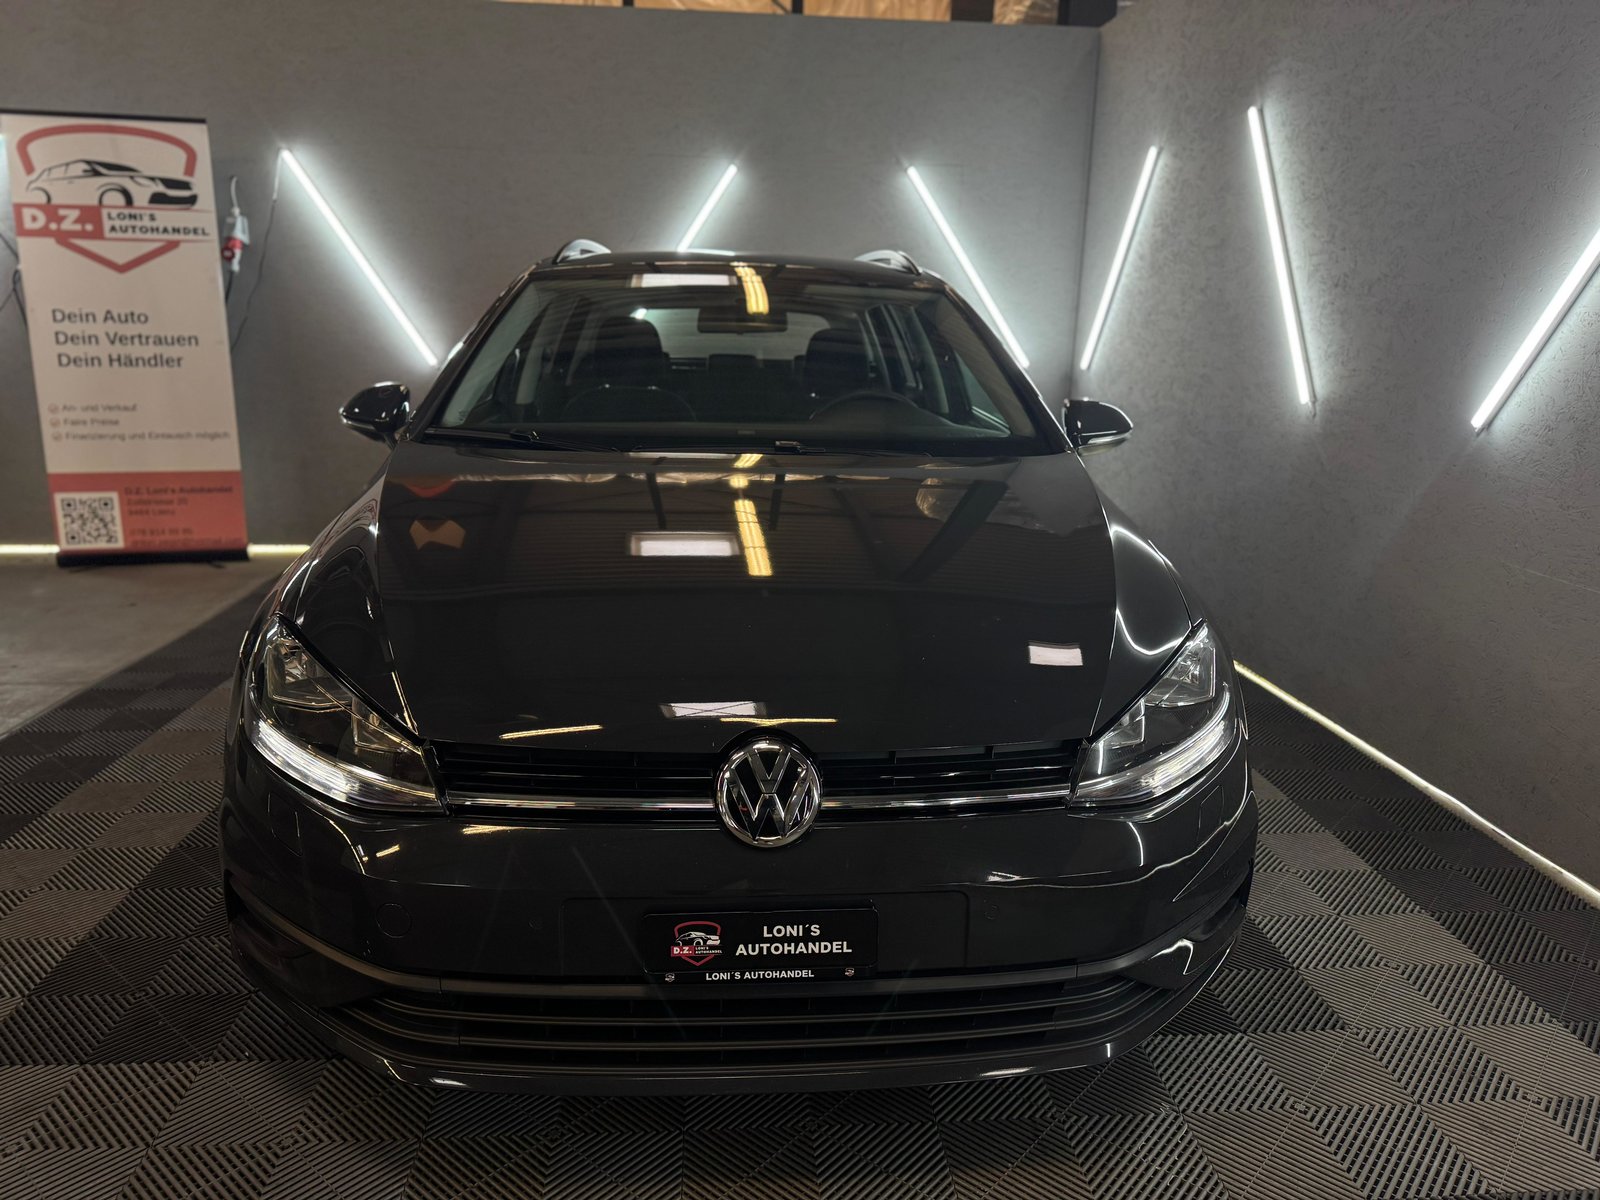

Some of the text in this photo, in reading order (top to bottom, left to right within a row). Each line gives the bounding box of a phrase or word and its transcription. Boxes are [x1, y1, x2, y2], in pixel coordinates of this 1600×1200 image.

[21, 206, 94, 231] D.Z.
[107, 211, 156, 222] LONI'S
[108, 224, 210, 237] AUTOHANDEL
[51, 308, 149, 324] Dein Auto
[54, 331, 199, 347] Dein Vertrauen
[57, 353, 183, 368] Dein Händler
[81, 403, 98, 412] und
[101, 403, 137, 412] Verkauf
[63, 418, 120, 426] Faire Preise
[65, 431, 126, 442] Finanzierung
[128, 431, 145, 440] und
[148, 431, 194, 440] Eintausch
[673, 946, 692, 955] D.Z.
[735, 941, 852, 956] AUTOHANDEL
[744, 969, 815, 979] AUTOHANDEL
